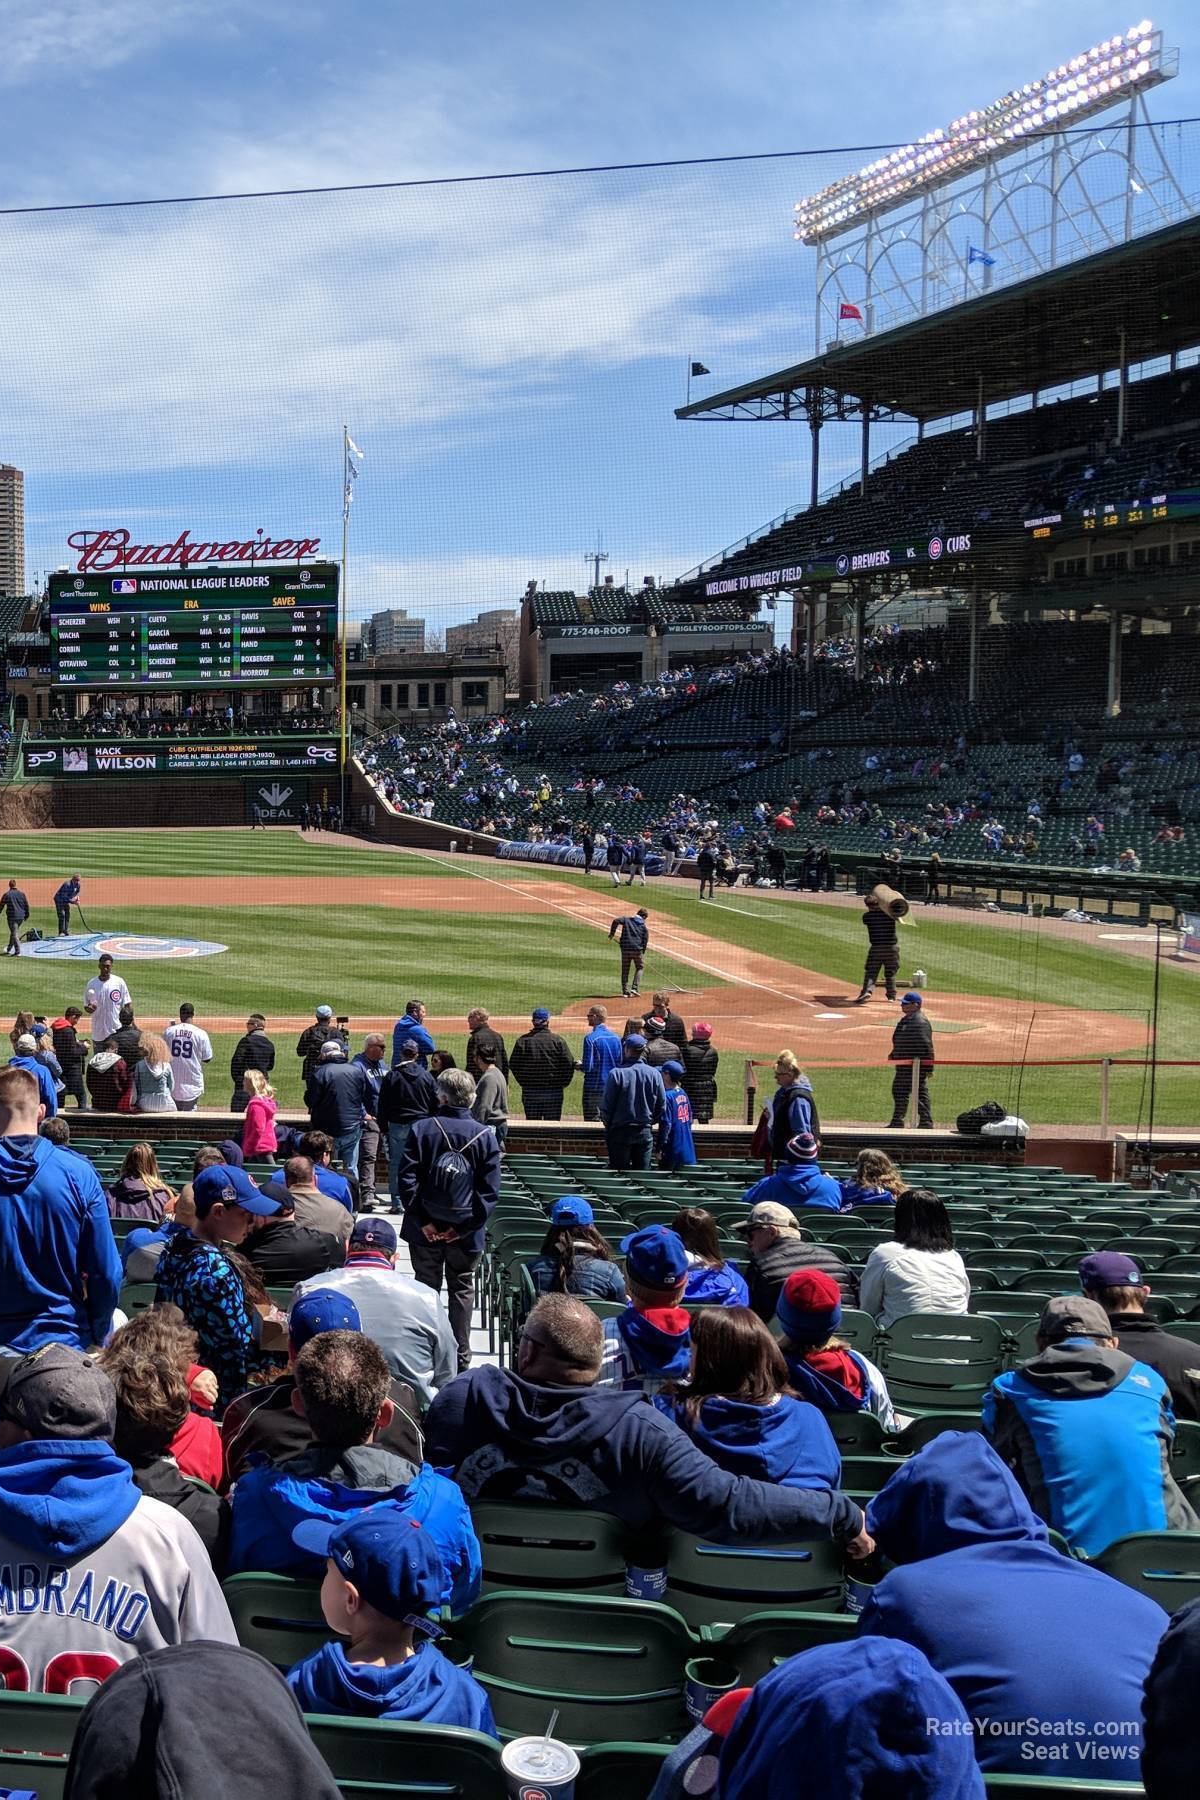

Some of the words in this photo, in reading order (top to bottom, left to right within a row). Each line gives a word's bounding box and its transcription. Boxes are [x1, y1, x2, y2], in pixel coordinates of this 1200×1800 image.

[67, 528, 321, 571] Budweiser
[852, 550, 890, 570] BREWERS
[946, 534, 971, 553] CUBS
[140, 579, 189, 591] NATIONAL
[192, 578, 227, 589] LEAGUE
[230, 576, 270, 587] LEADERS
[705, 579, 738, 596] WELCOME
[739, 576, 748, 590] TO
[749, 571, 781, 588] WRIGLEY
[782, 566, 802, 582] FIELD
[184, 600, 199, 609] ERA
[272, 596, 296, 607] SAVES
[90, 603, 111, 612] WINS
[59, 618, 86, 626] SCHERZER
[561, 627, 632, 637] 773-248-ROOF
[668, 624, 765, 633] WRIGLEYROOFTOPS.COM
[148, 642, 178, 650] MARTÍNEZ
[241, 655, 274, 663] BOXBERGER
[60, 660, 88, 668] OTTAVINO
[96, 748, 121, 756] HACK
[96, 757, 156, 769] WILSON
[260, 809, 294, 818] DEAL
[171, 1040, 193, 1059] 69
[365, 1232, 374, 1242] C
